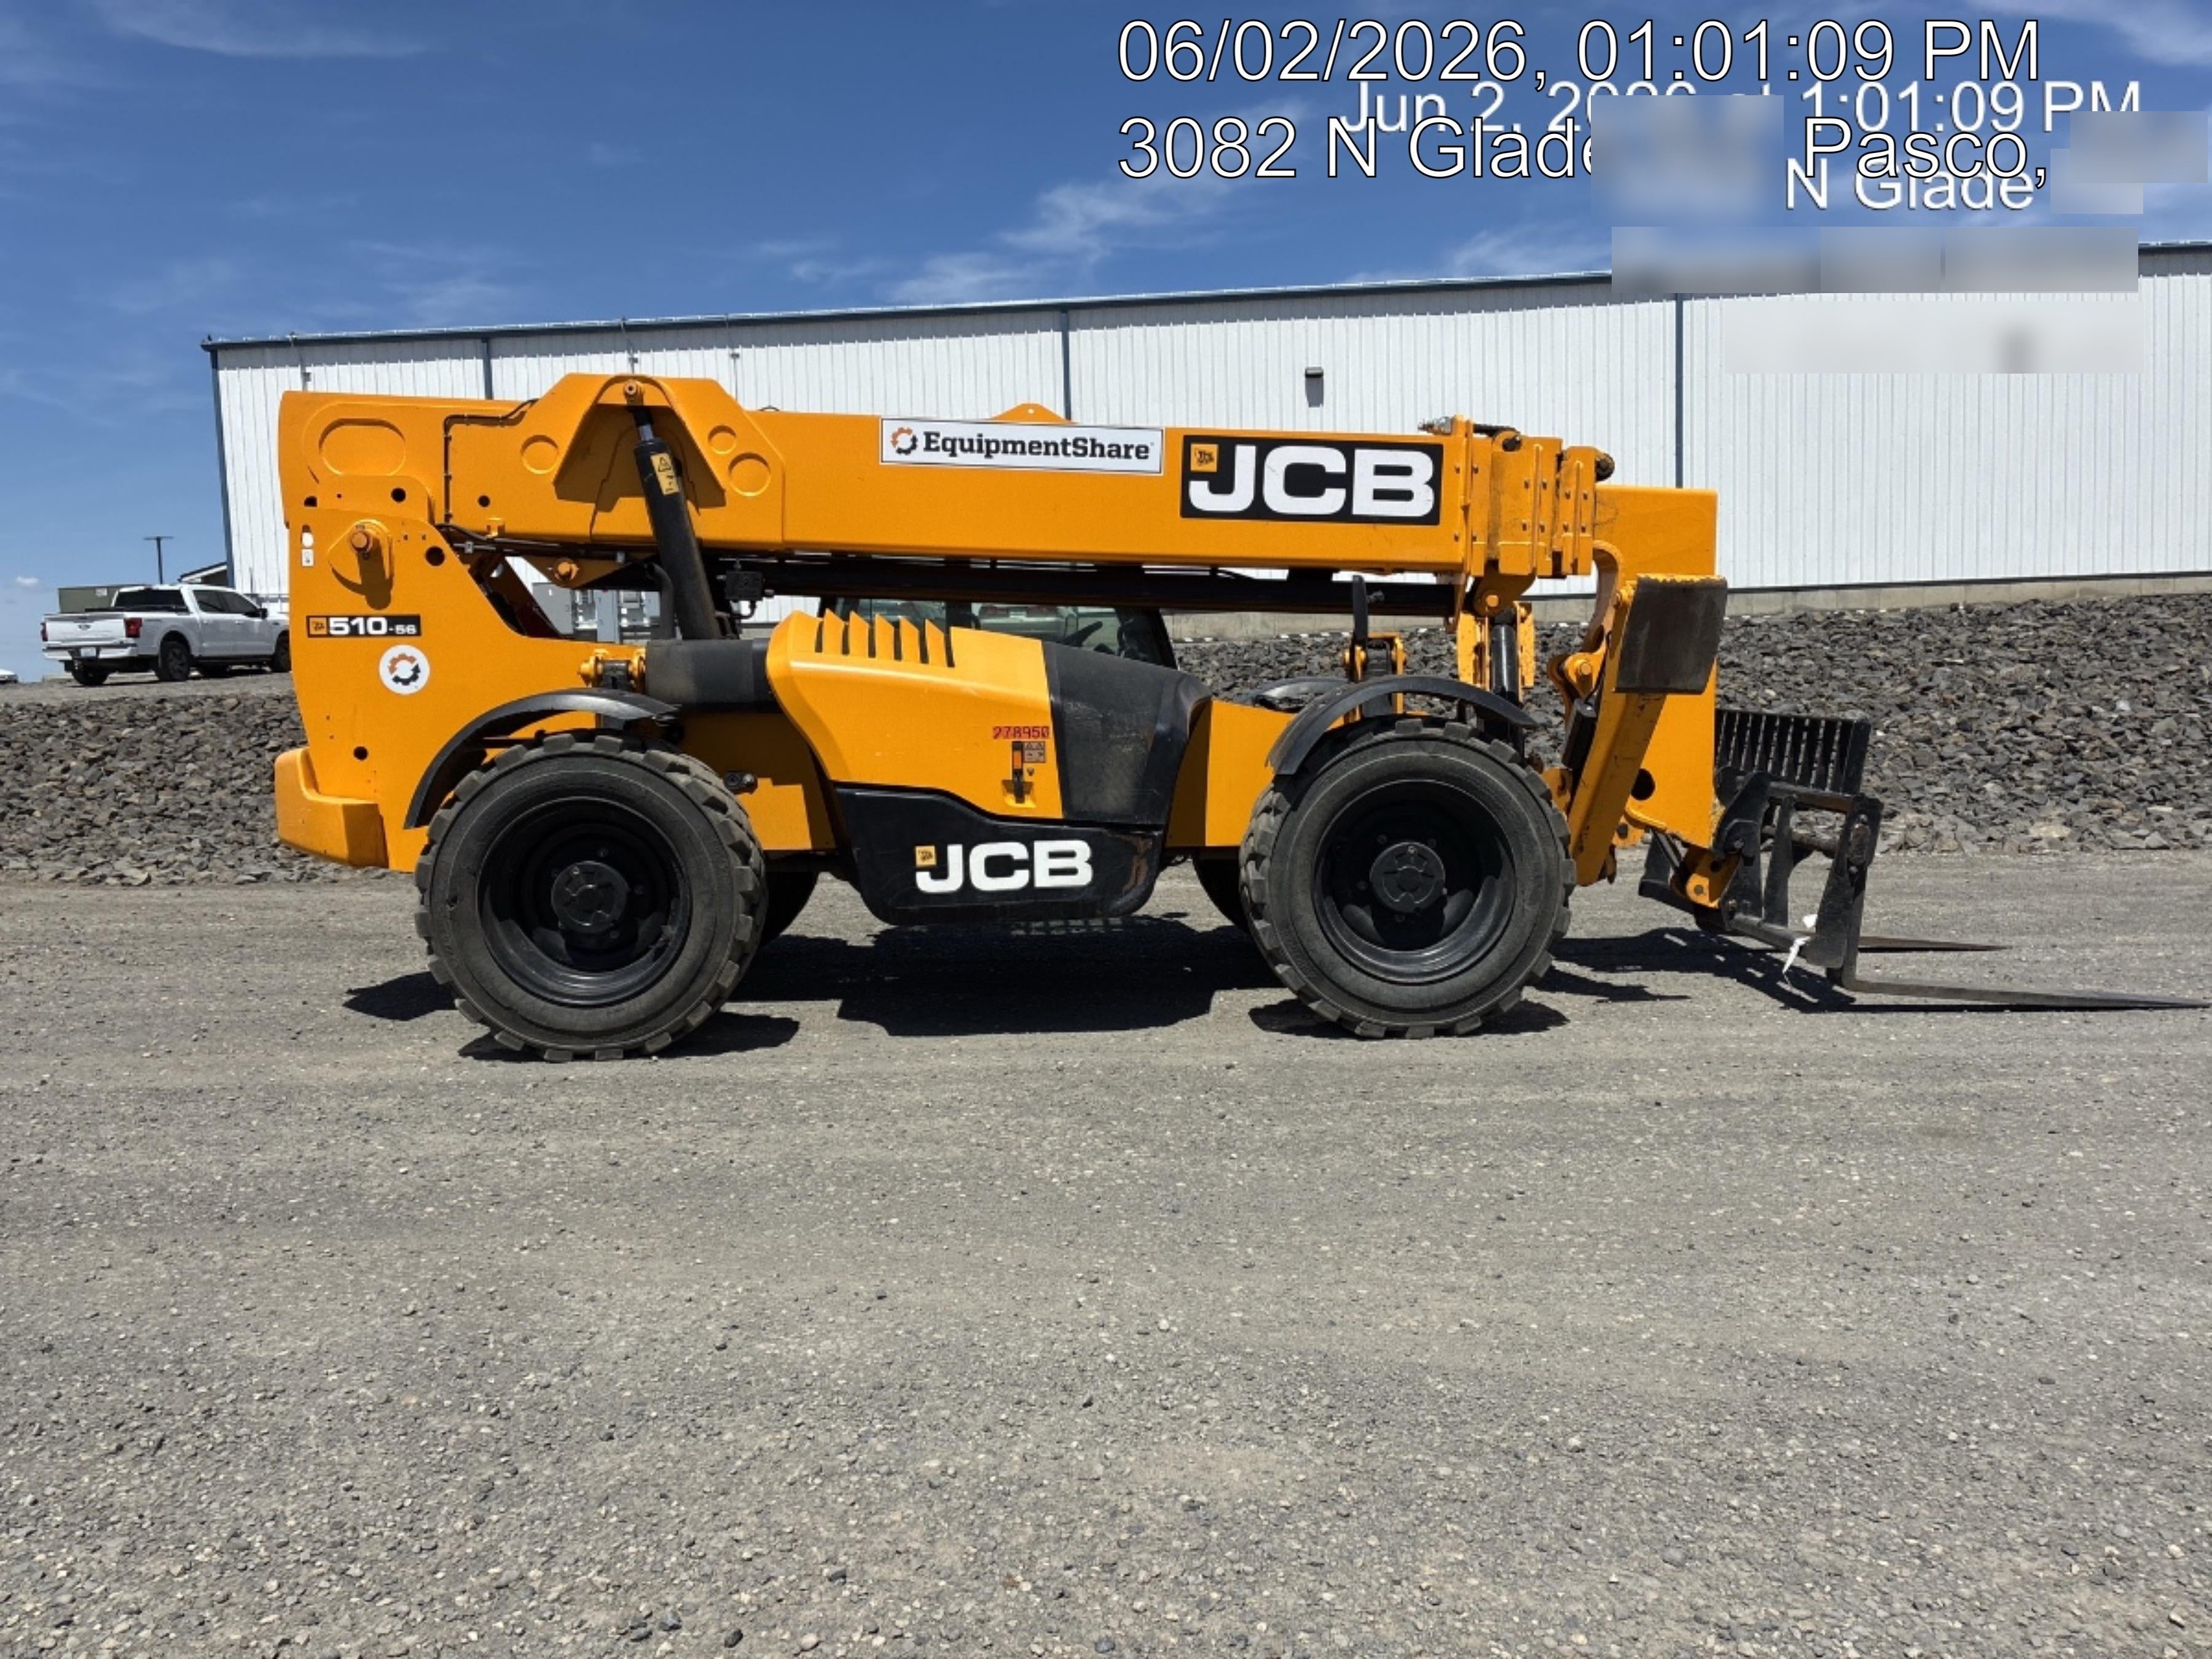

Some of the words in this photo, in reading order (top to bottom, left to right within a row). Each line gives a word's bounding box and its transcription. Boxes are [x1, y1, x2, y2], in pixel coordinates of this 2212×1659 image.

[924, 432, 1150, 460] EquipmentShare
[1189, 444, 1434, 517] JCB
[916, 839, 1092, 893] JCB
